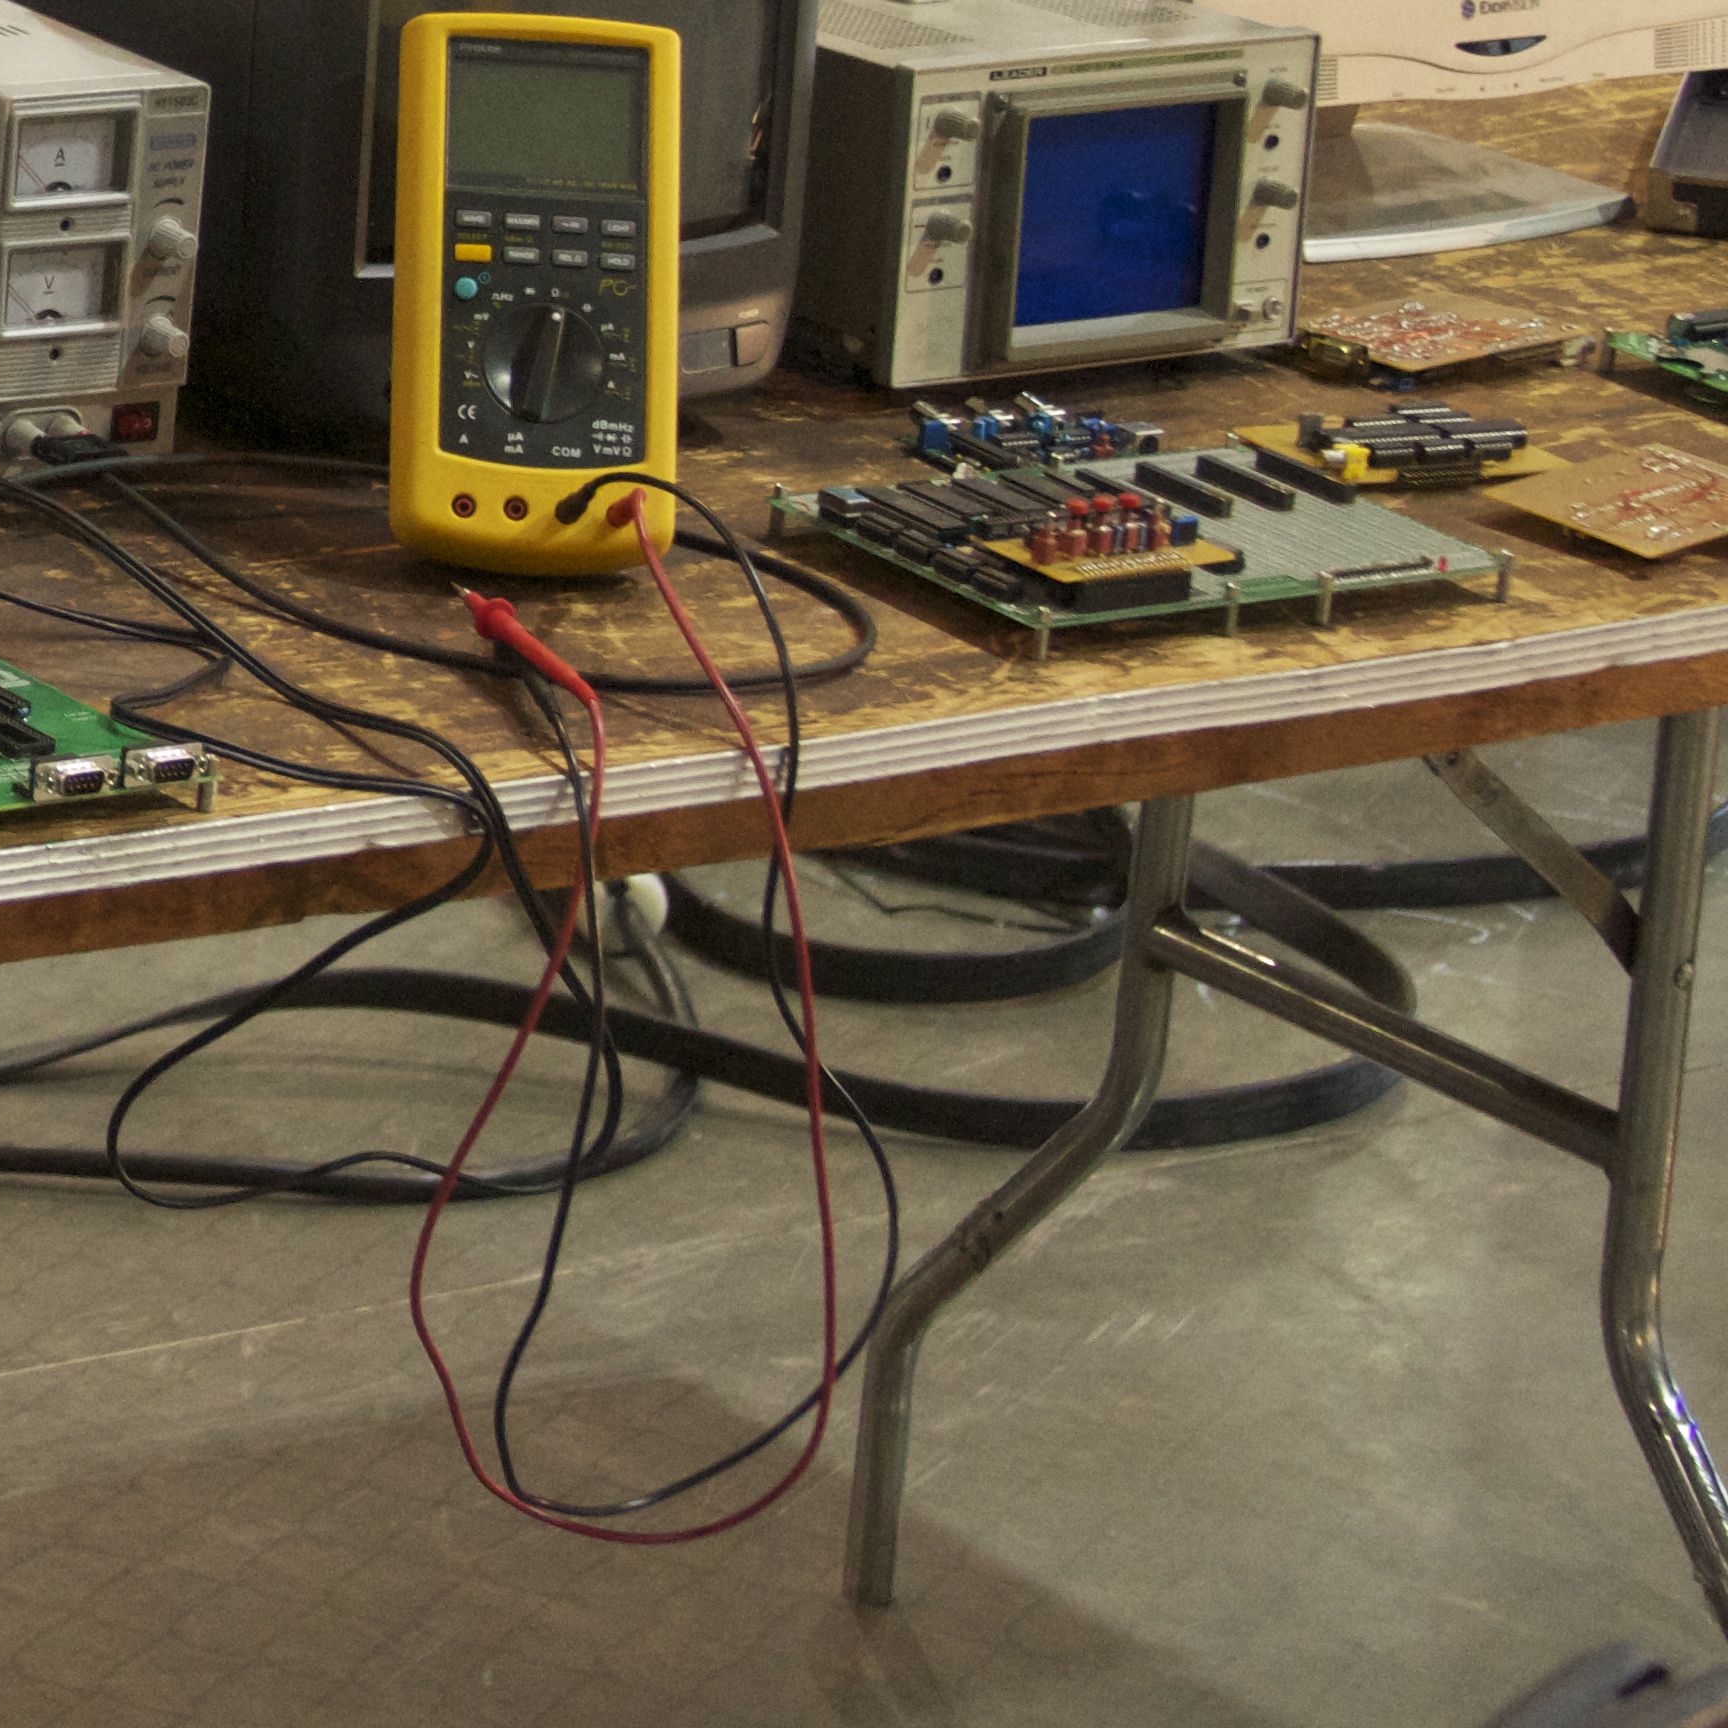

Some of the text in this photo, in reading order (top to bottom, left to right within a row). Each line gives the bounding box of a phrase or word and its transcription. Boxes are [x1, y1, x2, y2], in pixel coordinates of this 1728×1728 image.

[54, 146, 66, 163] A
[607, 257, 630, 266] HOLD
[44, 275, 56, 290] V
[457, 404, 478, 420] CE
[459, 434, 469, 445] A
[504, 444, 524, 455] mA
[551, 446, 582, 459] COM
